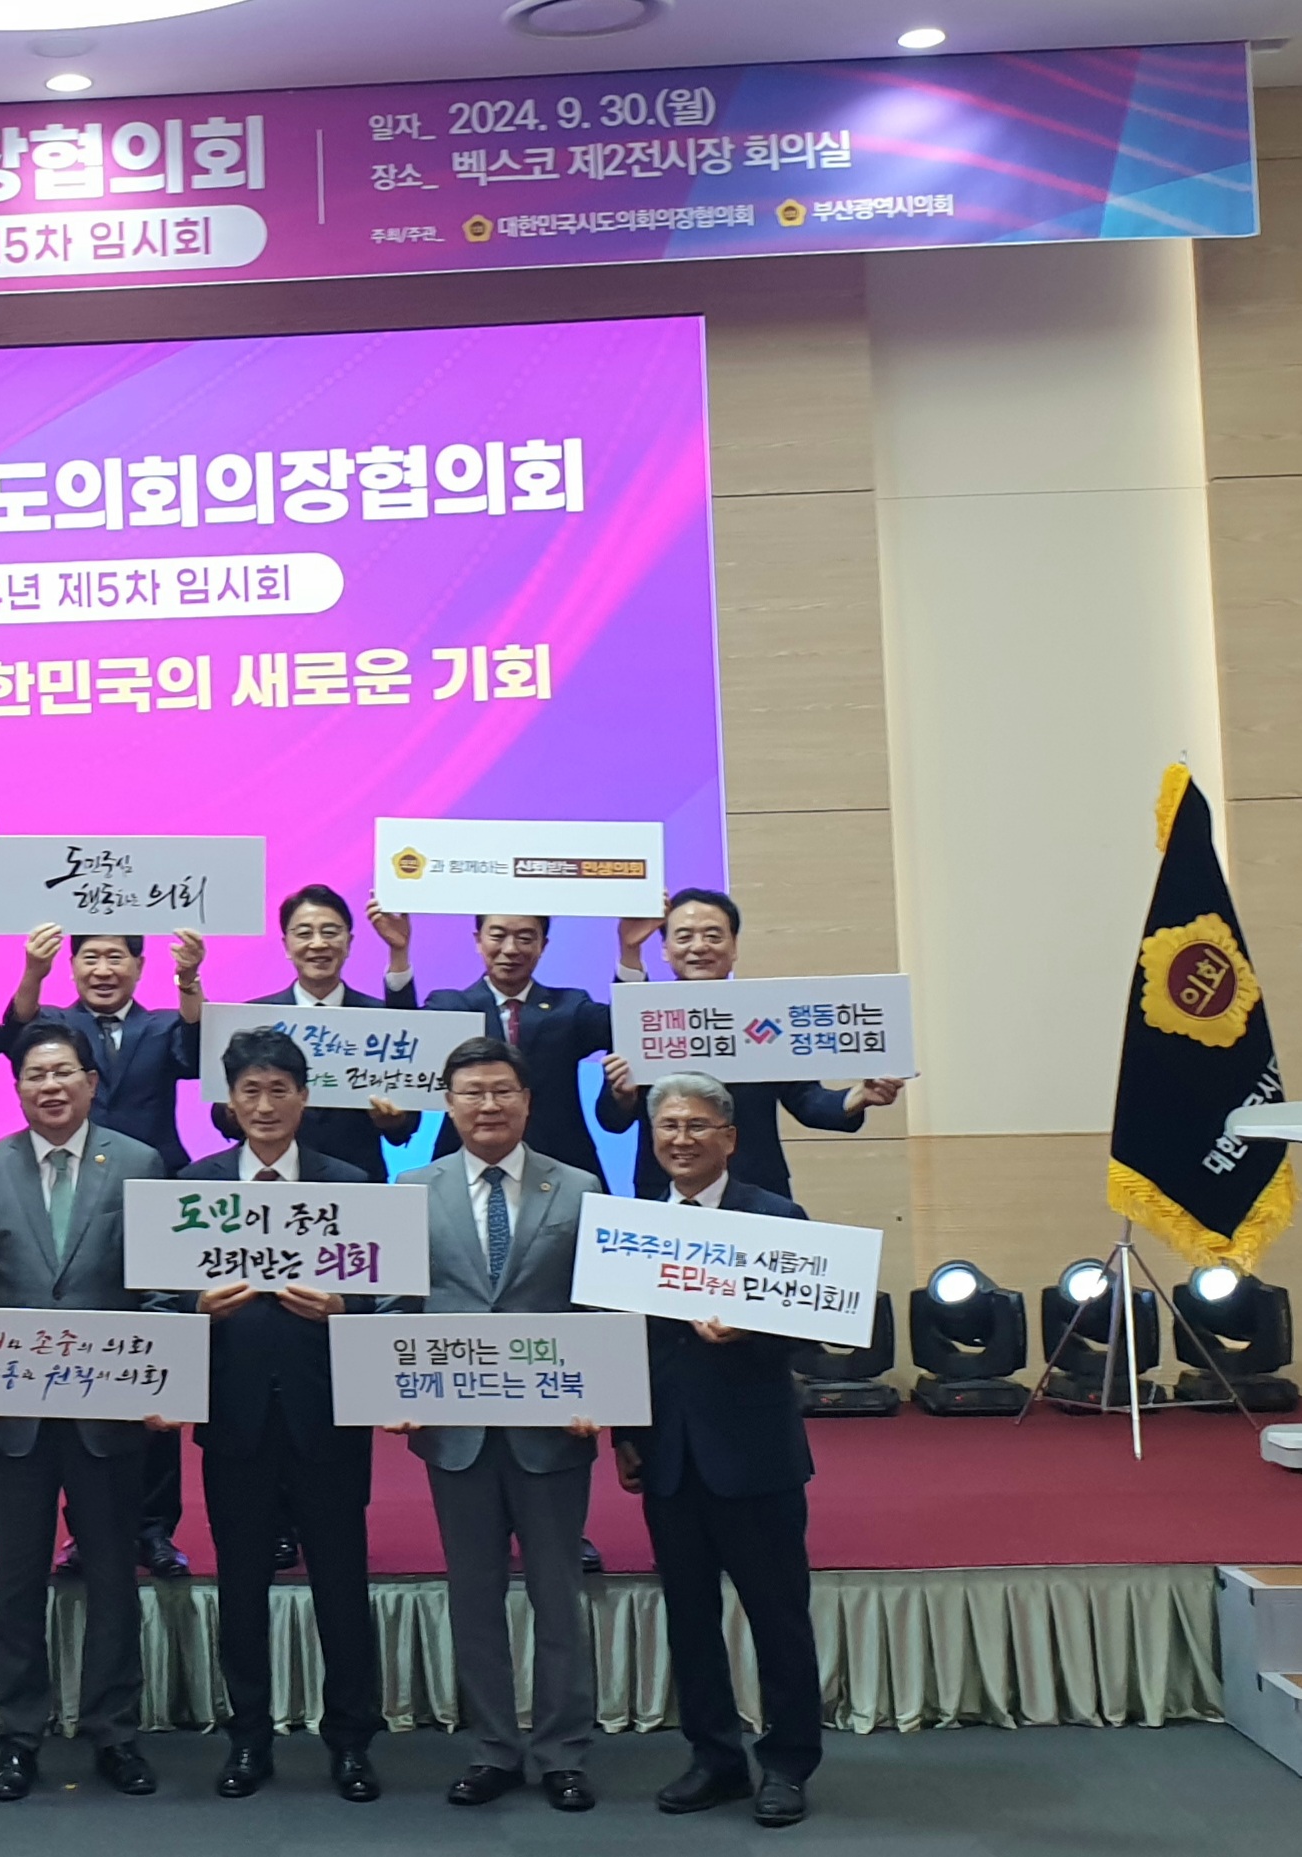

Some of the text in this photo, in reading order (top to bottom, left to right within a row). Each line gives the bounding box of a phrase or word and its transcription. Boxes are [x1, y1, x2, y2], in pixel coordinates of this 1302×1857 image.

[448, 99, 547, 136] 2024.
[557, 97, 591, 131] 9.
[599, 87, 716, 129] 30.(월)
[451, 146, 560, 187] 벡스코
[567, 136, 733, 180] 제2전시장
[743, 130, 853, 170] 회의실
[497, 204, 755, 238] 대한민국시도의회의장협의회
[811, 194, 955, 222] 부산광역시의회
[88, 215, 214, 262] 임시회
[57, 565, 159, 610] 제5차
[177, 563, 292, 605] 임시회
[231, 648, 411, 709] 새로운
[431, 642, 550, 703] 기회
[44, 845, 134, 889] 도민중심
[73, 875, 207, 924] 행동하는 의회
[1179, 948, 1230, 1014] 의회
[640, 1007, 735, 1032] 함께하는
[788, 1003, 884, 1028] 행동하는
[302, 1024, 358, 1057] 잘하는
[364, 1029, 419, 1063] 의회
[641, 1035, 737, 1060] 민생의회
[788, 1030, 886, 1056] 정책의회
[171, 1193, 341, 1236] 도민이 중심
[198, 1242, 380, 1283] 신뢰받는 의회
[596, 1227, 828, 1278] 민주주의 가치를 새롭게!
[658, 1263, 860, 1315] 도민중심 민생의회!!
[30, 1330, 93, 1356] 존중의
[102, 1335, 153, 1354] 의회
[393, 1338, 565, 1367] 일 잘하는 의회,
[42, 1364, 111, 1400] 원칙의
[115, 1365, 168, 1396] 의회
[395, 1371, 584, 1399] 함께 만드는 전북
